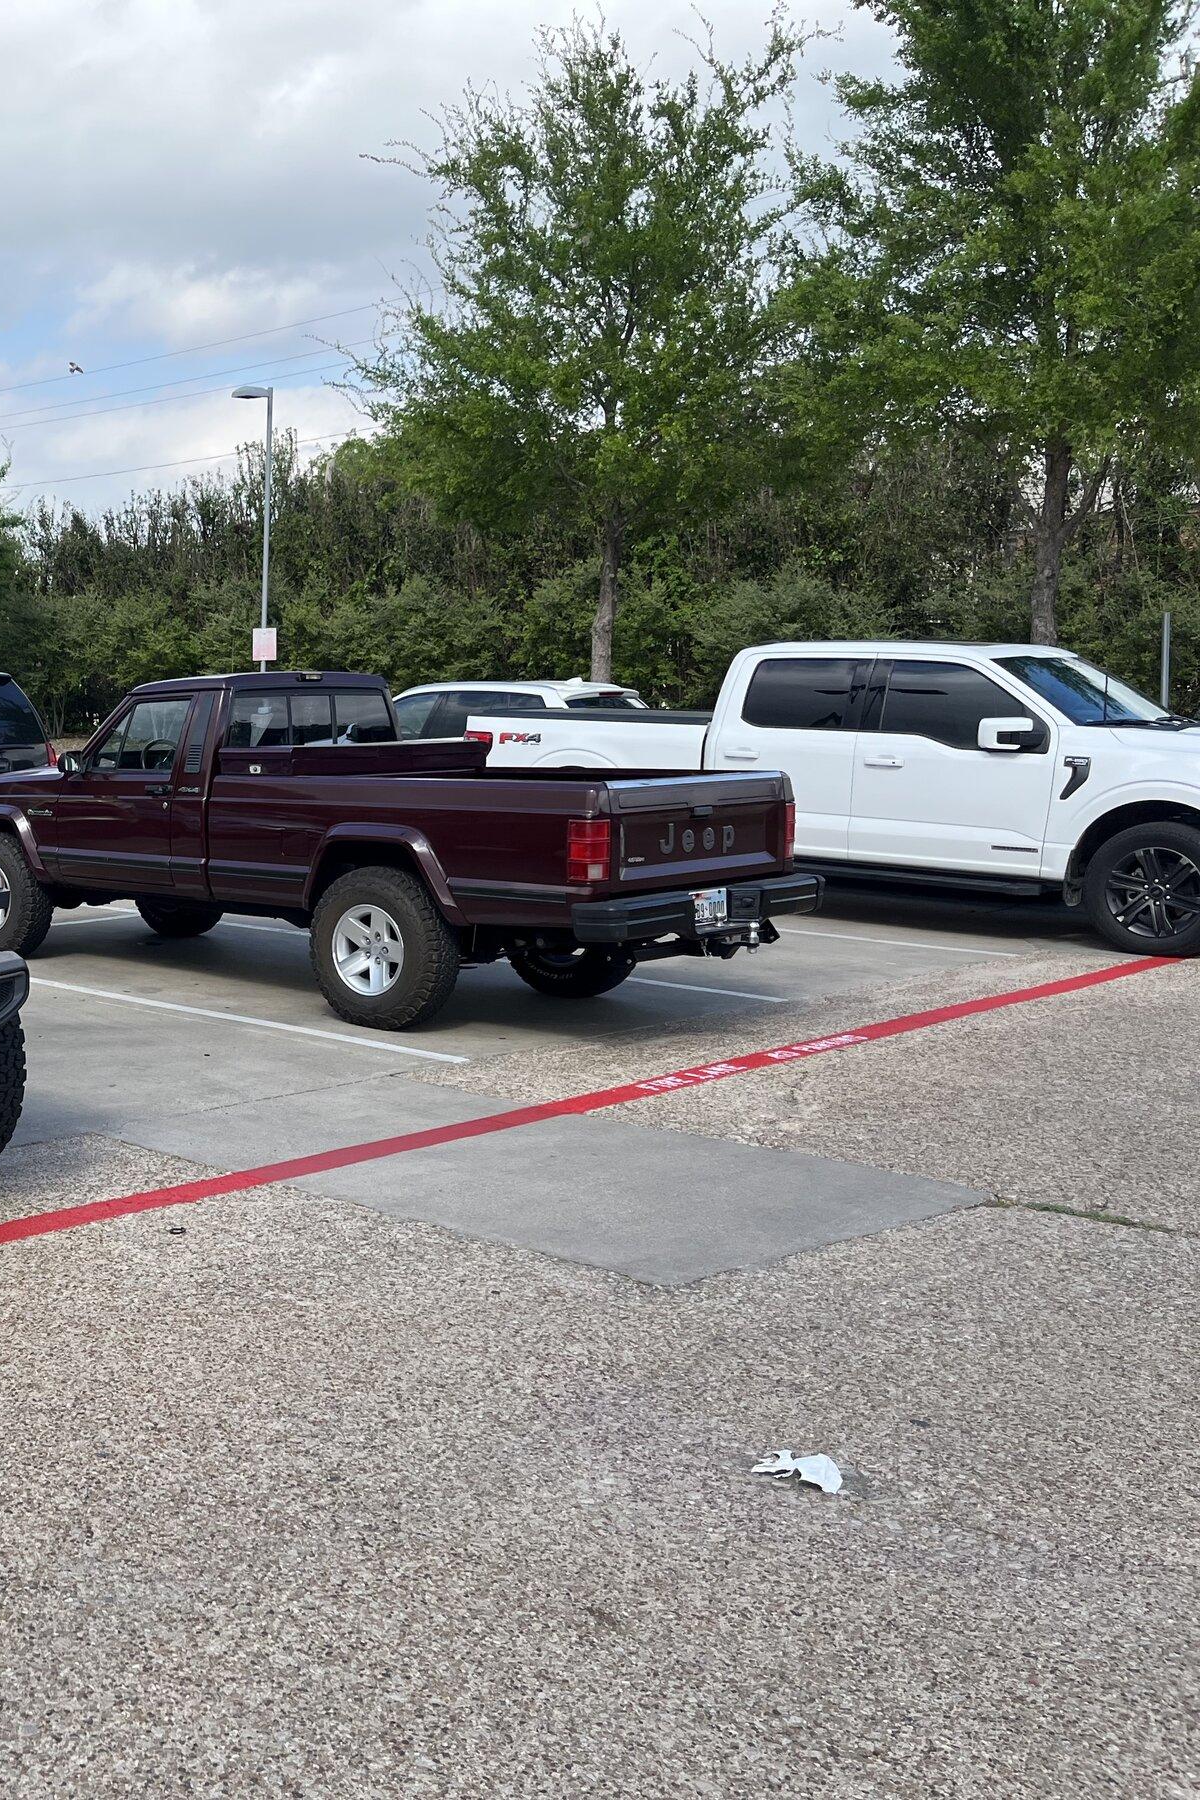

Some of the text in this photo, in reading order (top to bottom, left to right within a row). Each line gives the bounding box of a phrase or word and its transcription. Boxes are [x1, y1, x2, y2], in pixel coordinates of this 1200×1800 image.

[499, 732, 541, 744] FX4
[659, 822, 735, 855] Jeep
[636, 1076, 694, 1091] FIRE
[684, 1063, 747, 1079] LANE
